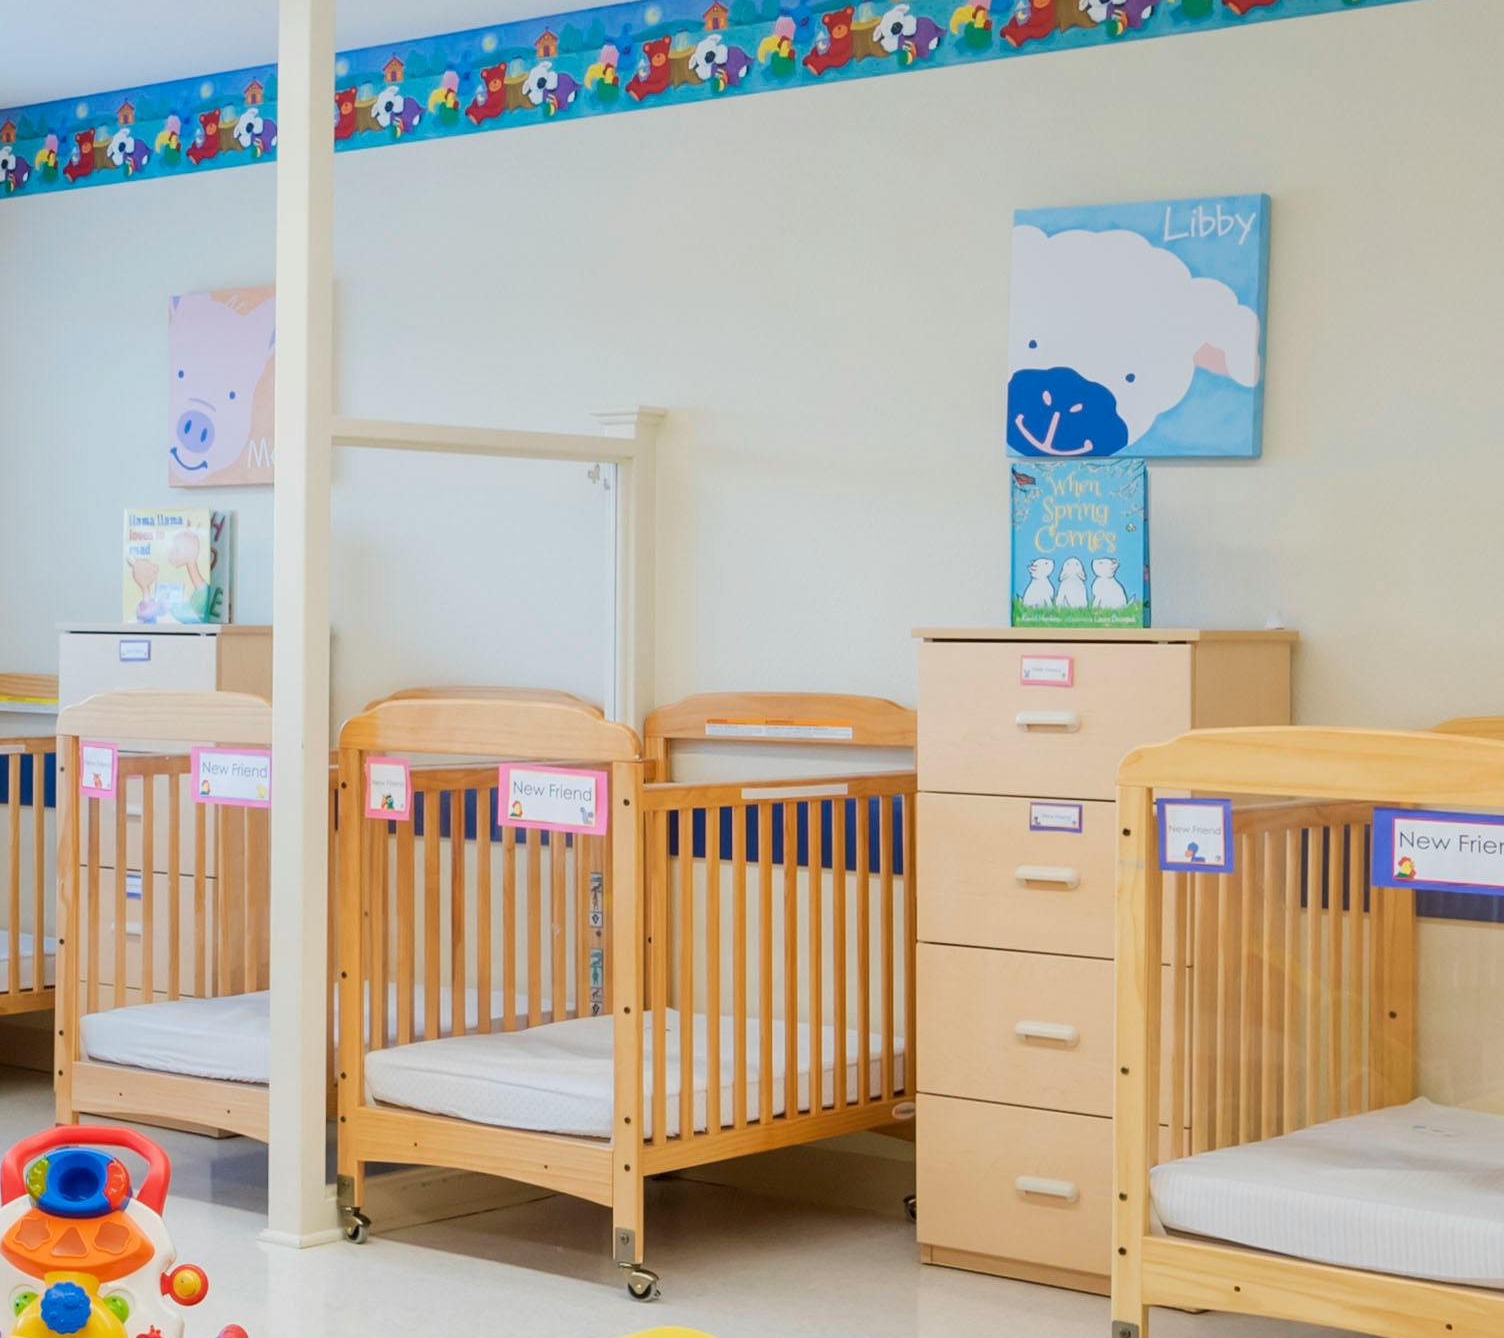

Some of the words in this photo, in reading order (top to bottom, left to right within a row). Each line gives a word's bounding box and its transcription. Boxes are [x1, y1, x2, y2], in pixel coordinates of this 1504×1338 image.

[1163, 204, 1257, 246] Libby
[247, 436, 275, 469] M
[1046, 469, 1101, 497] When
[1043, 496, 1109, 527] Spring
[1034, 525, 1118, 553] Comes
[202, 761, 229, 775] New
[231, 762, 268, 779] Friend
[513, 780, 546, 797] New
[549, 783, 593, 802] Friend
[1168, 824, 1190, 835] New
[1192, 824, 1222, 837] Friend
[1399, 830, 1452, 852] New
